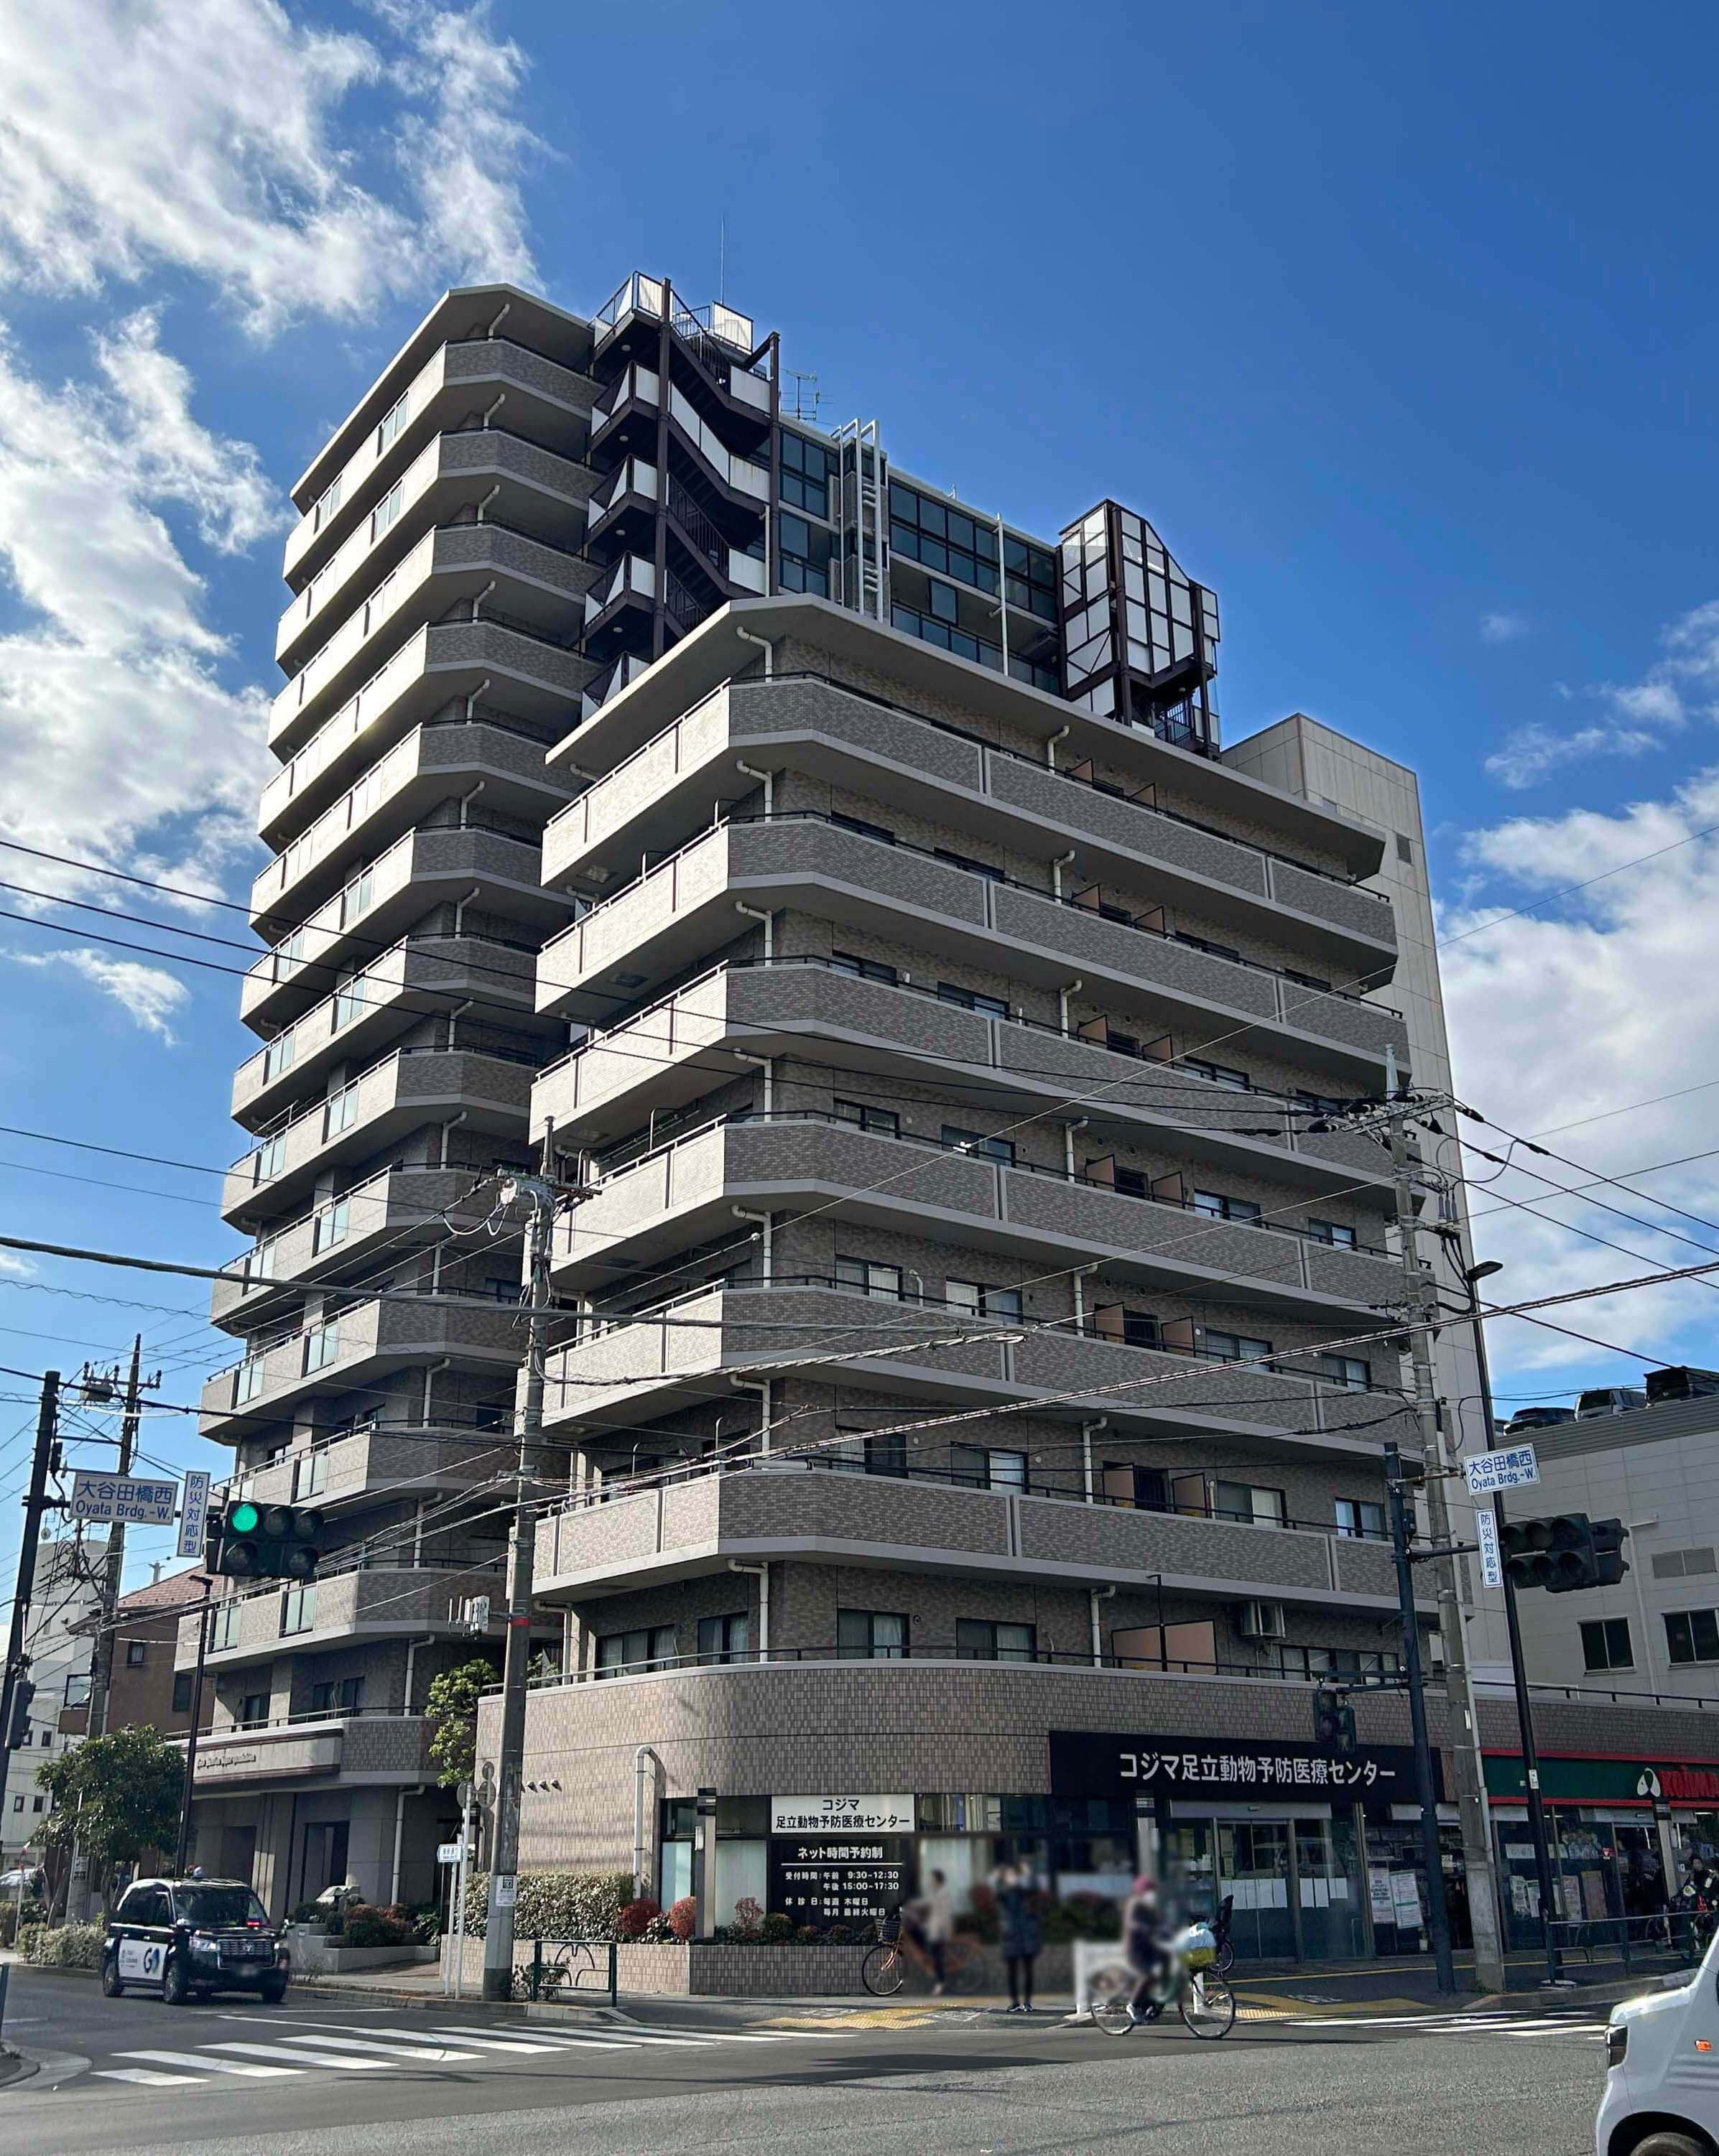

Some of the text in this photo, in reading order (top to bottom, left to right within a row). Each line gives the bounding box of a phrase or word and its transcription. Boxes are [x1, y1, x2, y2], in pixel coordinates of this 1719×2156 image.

[1468, 1449, 1532, 1476] 大谷田橋西
[77, 1480, 174, 1504] 大谷田橋西
[1472, 1477, 1496, 1490] Oyata
[75, 1500, 111, 1516] Oyata
[184, 1475, 204, 1553] 防災対応型
[1481, 1513, 1498, 1583] 防災対応型
[1120, 1752, 1396, 1786] コジマ足立動物予防医療センター
[823, 1798, 860, 1811] コジマ
[776, 1815, 909, 1829] 足立動物予防医療センター
[797, 1846, 883, 1859] ネット時間予約制
